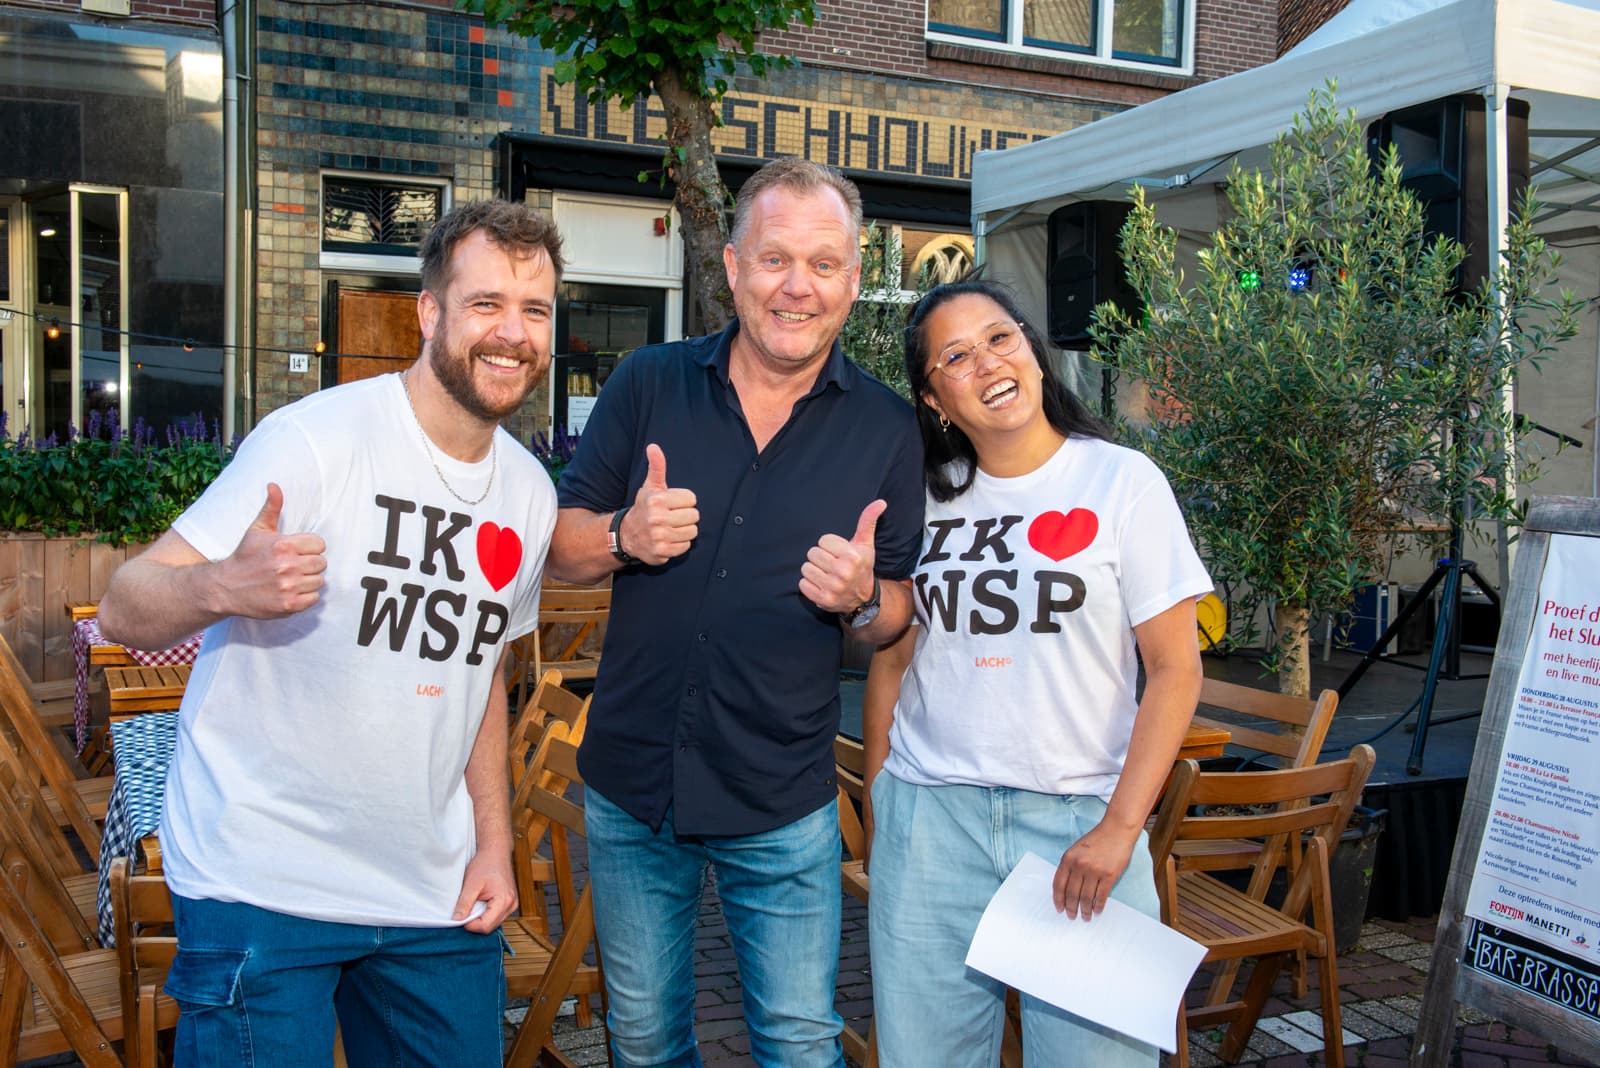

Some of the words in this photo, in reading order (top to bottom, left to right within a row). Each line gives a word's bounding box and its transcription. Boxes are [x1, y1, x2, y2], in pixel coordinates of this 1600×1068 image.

[368, 494, 472, 582] IK
[919, 515, 1024, 566] IK
[914, 569, 1087, 635] WSP
[1543, 600, 1587, 620] Proef
[357, 576, 509, 666] WSP
[1549, 622, 1575, 642] het
[1544, 652, 1564, 663] met
[1566, 653, 1600, 672] heerlij
[1545, 668, 1558, 678] en
[1561, 668, 1579, 682] live
[1521, 687, 1558, 700] DONDERDAG
[1567, 697, 1598, 709] AUGUSTUS
[1507, 752, 1531, 765] VRIJDAG
[1539, 761, 1570, 774] AUGUSTUS
[1498, 885, 1515, 898] Deze
[1517, 893, 1552, 911] optredens
[1554, 906, 1584, 922] worden
[1489, 900, 1525, 921] FONTIJN
[1525, 913, 1570, 937] MANETTI
